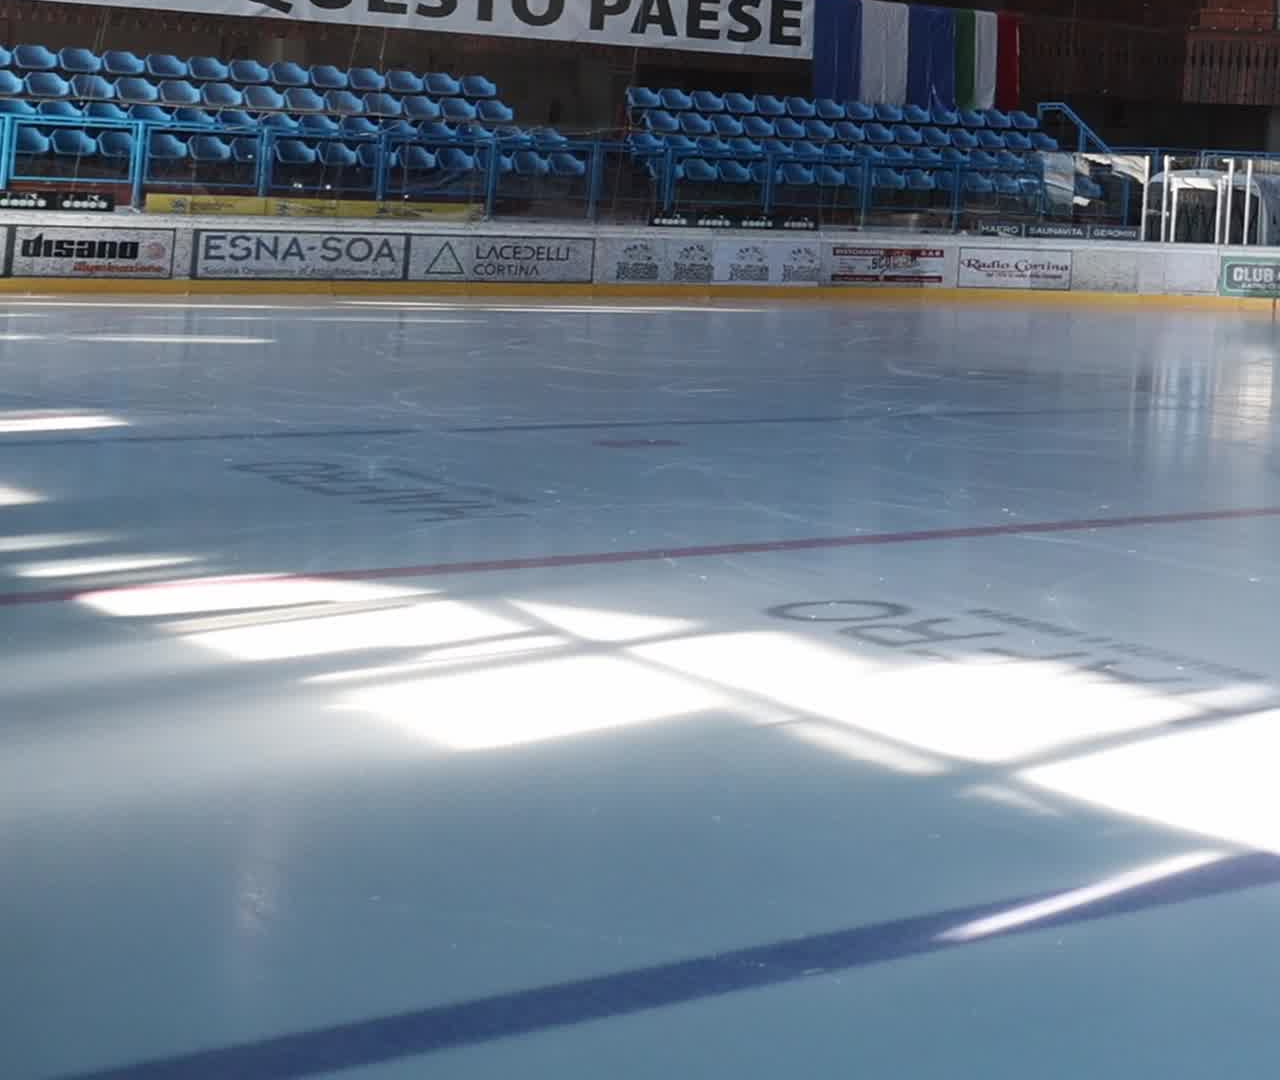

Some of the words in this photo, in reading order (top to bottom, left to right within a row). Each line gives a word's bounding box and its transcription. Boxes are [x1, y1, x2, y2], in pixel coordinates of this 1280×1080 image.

[21, 232, 139, 259] disano
[204, 235, 396, 262] ESNA-SOA
[476, 245, 570, 261] LACEDELLI
[473, 264, 539, 276] CORTINA
[961, 258, 1010, 271] Radio
[1015, 259, 1069, 272] Cortina
[1233, 267, 1274, 282] CLUB
